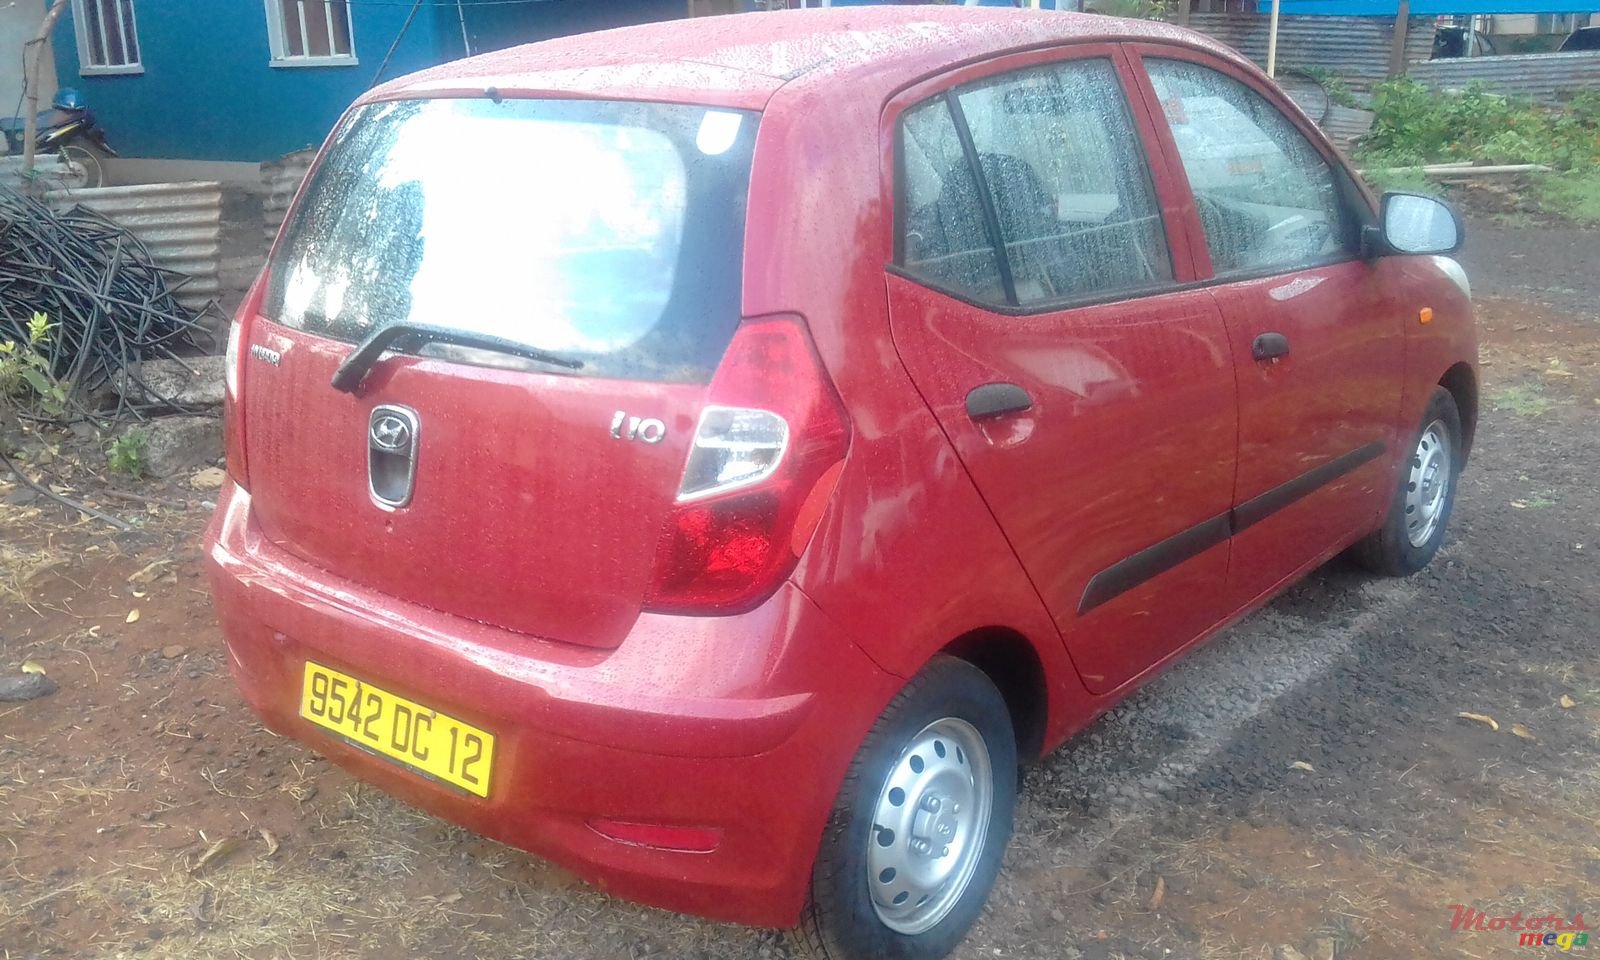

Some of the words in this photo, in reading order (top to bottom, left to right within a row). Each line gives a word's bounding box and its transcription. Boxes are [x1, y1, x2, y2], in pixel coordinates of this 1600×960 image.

[310, 671, 383, 742] 9542
[391, 704, 432, 761] DC
[449, 727, 483, 785] 12
